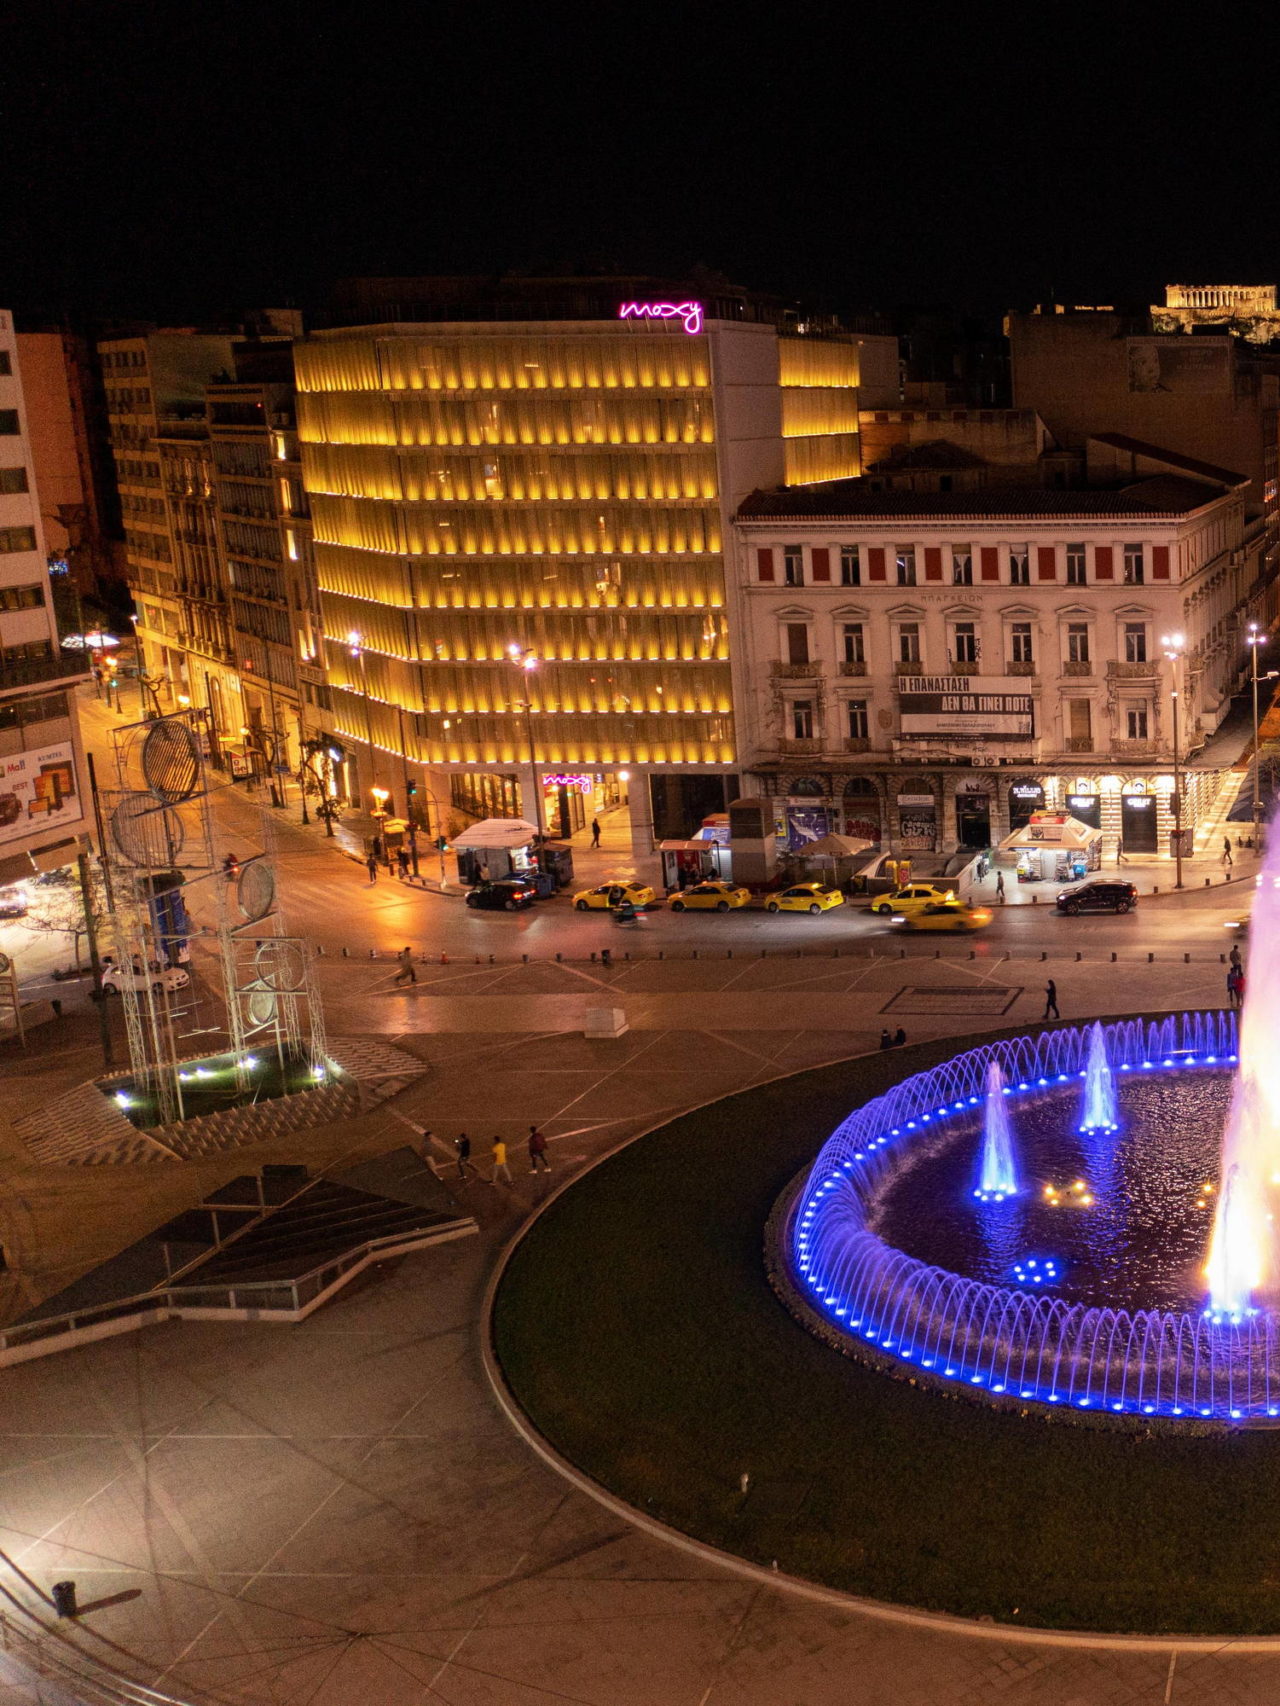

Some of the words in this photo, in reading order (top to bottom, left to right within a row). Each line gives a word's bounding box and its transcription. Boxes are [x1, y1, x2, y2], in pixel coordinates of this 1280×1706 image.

[619, 302, 702, 334] moxy
[900, 678, 907, 692] Η
[909, 678, 970, 692] ΕΠΑΝΑΣΤΑΣΗ
[942, 696, 960, 711] ΔΕΝ
[962, 696, 976, 711] ΘΑ
[979, 697, 1003, 711] ΓΙΝΕΙ
[1006, 697, 1029, 712] ΠΟΤΕ
